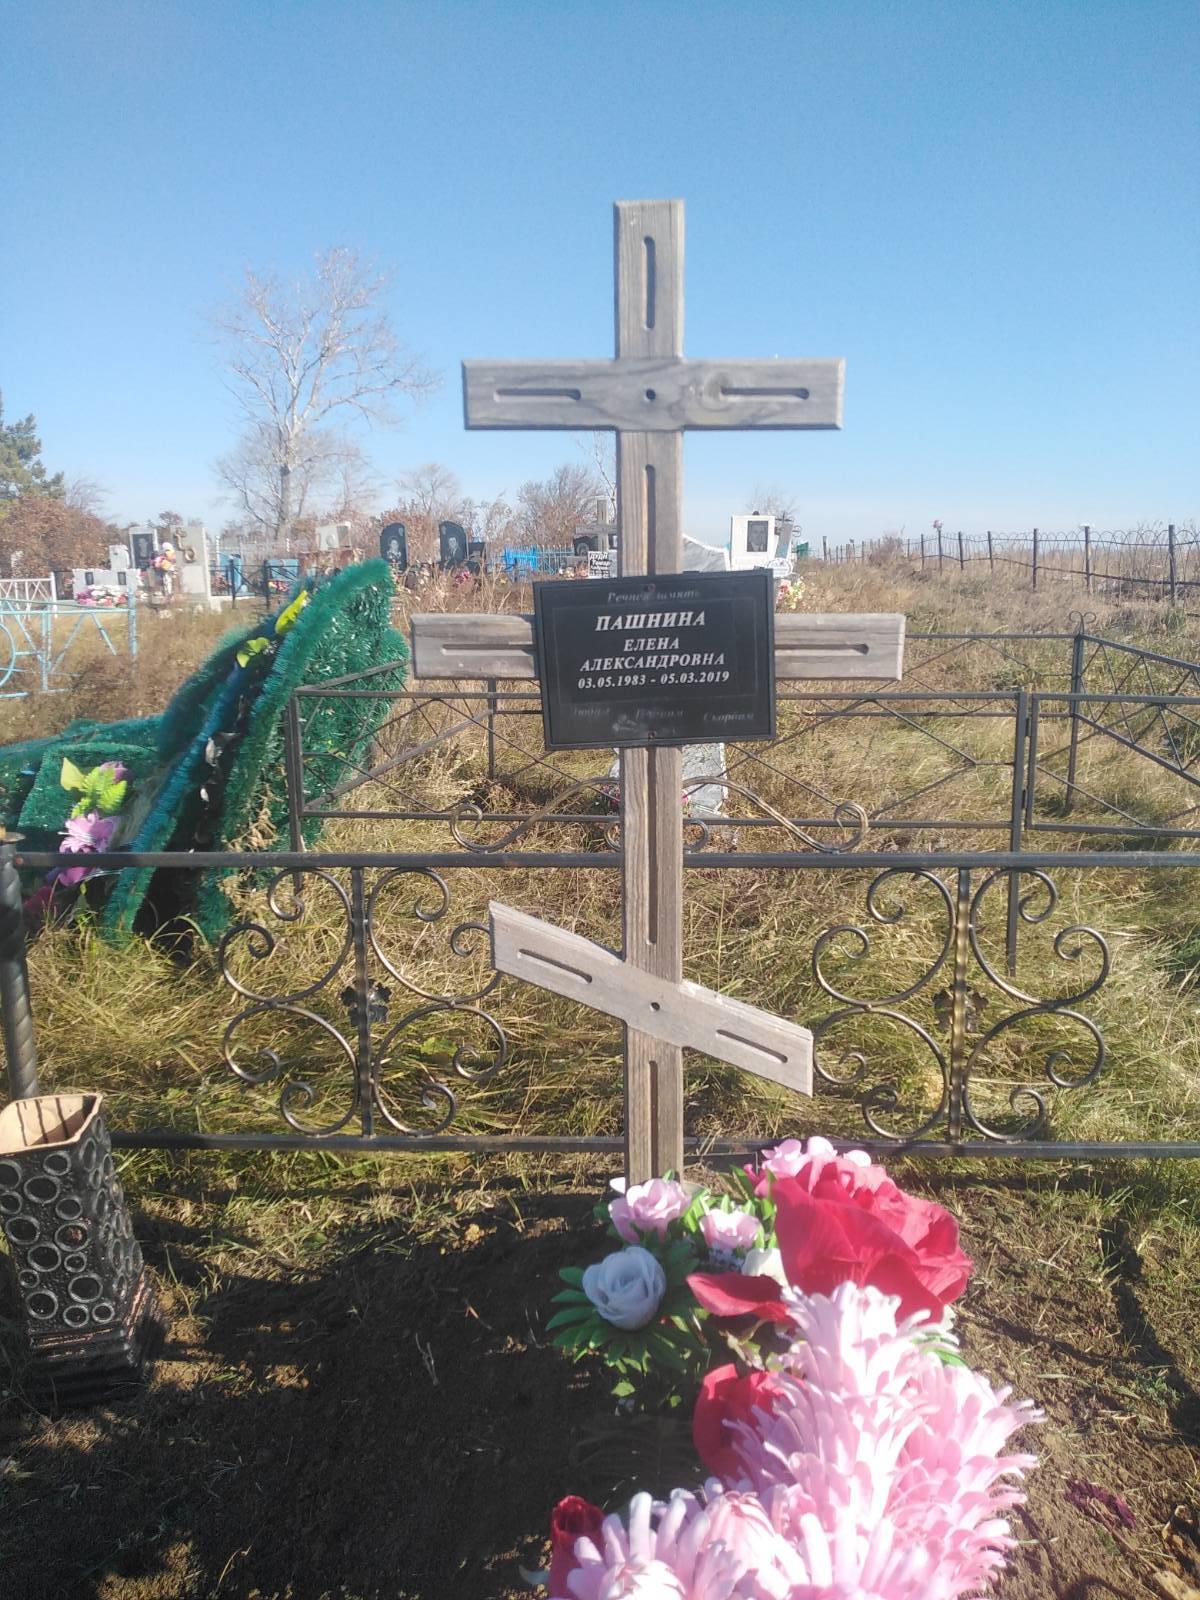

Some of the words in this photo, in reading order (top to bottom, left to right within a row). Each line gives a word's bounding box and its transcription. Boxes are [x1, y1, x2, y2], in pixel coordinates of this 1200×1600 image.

[595, 611, 706, 631] ПАШНИНА
[624, 637, 680, 652] ЕЛЕНА
[580, 653, 725, 672] АЛЕКСАНДРОВНА
[578, 675, 647, 689] 03.05.1983
[660, 671, 730, 684] 05.03.2019
